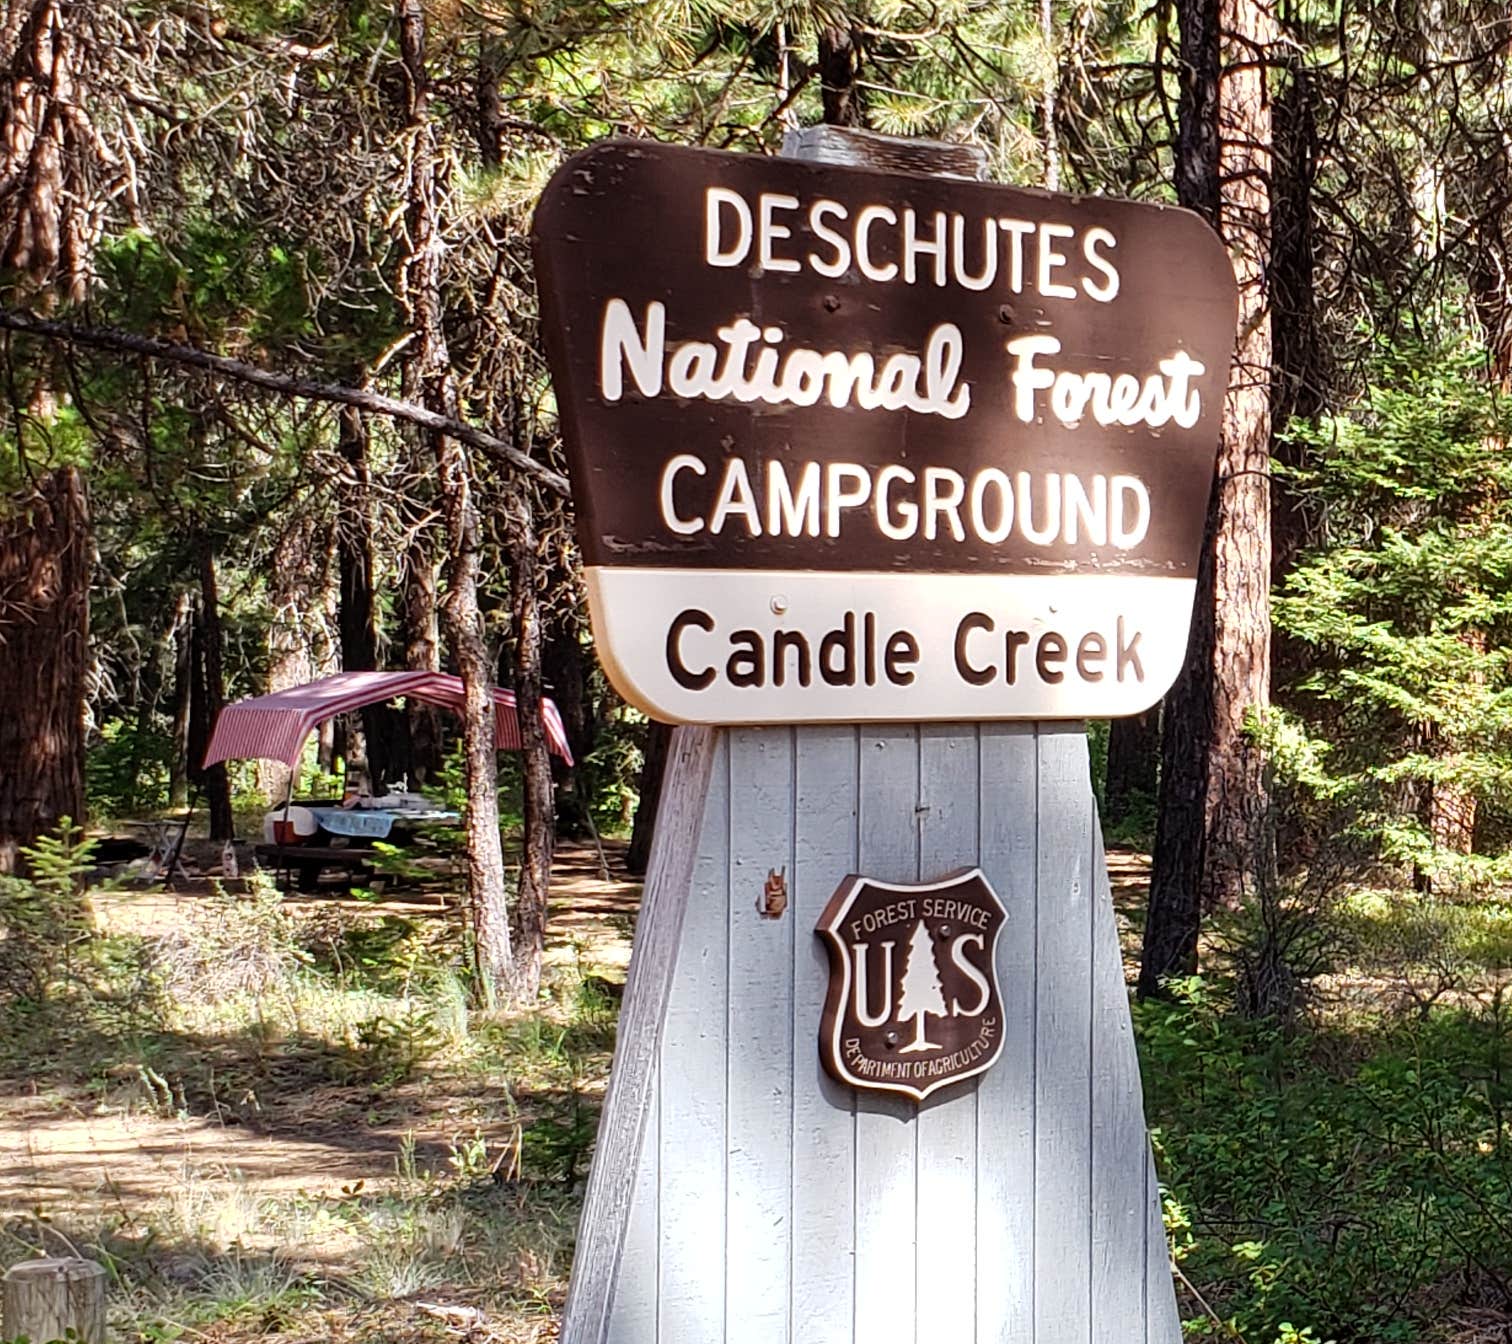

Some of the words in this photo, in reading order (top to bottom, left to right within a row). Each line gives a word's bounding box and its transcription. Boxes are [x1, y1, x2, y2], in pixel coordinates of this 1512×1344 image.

[705, 187, 1120, 303] DESCHUTES
[601, 298, 971, 420] National
[1007, 334, 1206, 429] Forest
[660, 454, 1151, 550] CAMPGROUND
[666, 607, 920, 692] Candle
[953, 610, 1146, 685] Creek
[851, 899, 917, 941] FOREST
[922, 898, 993, 931] SERVICE
[852, 941, 896, 1028] U
[951, 933, 990, 1018] S
[845, 1037, 912, 1079] DEPARTMENT
[913, 1062, 930, 1079] OF
[928, 1016, 997, 1076] AGRICULTURE
